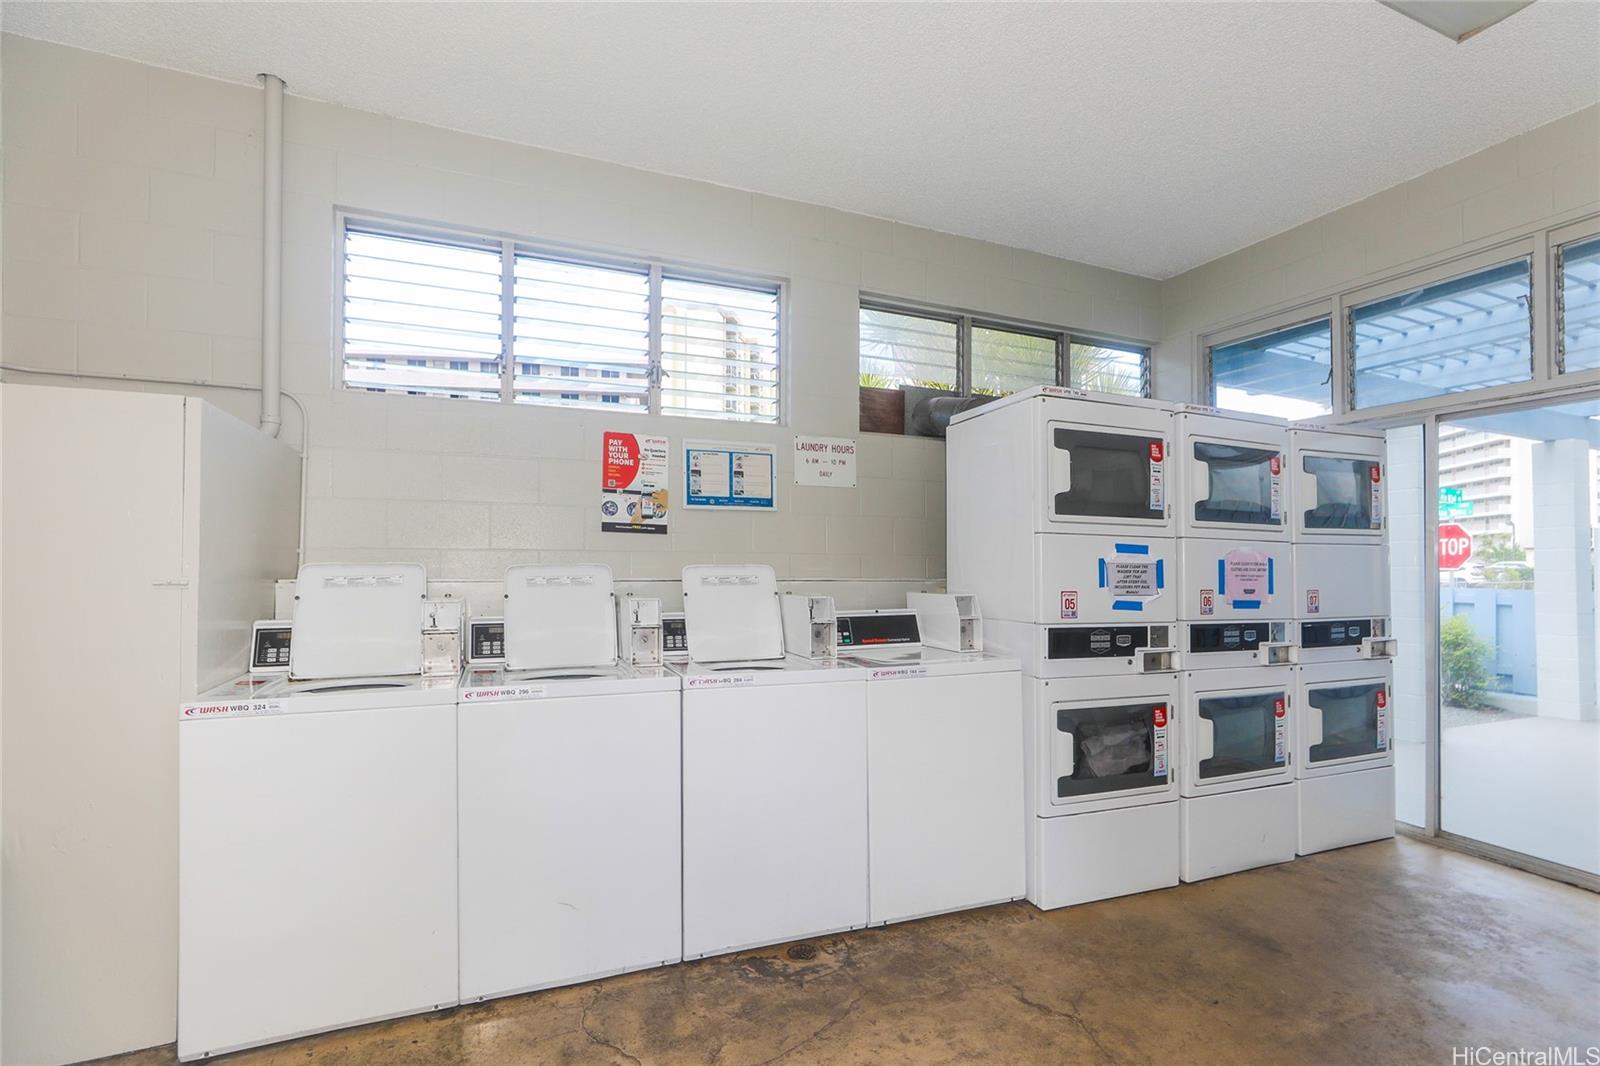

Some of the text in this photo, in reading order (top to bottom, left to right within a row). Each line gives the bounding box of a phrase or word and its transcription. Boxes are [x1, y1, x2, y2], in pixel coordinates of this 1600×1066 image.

[609, 438, 623, 446] PAY
[796, 441, 855, 455] LAUNDRY HOURS
[608, 451, 629, 459] YOUR
[608, 457, 635, 466] PHONE
[819, 470, 833, 478] DAILY
[1065, 598, 1075, 610] 05
[1203, 596, 1212, 607] 06
[1310, 595, 1317, 605] 07
[476, 690, 500, 698] WASH
[200, 705, 229, 714] WASH
[230, 704, 250, 712] WBQ
[252, 703, 267, 711] 324
